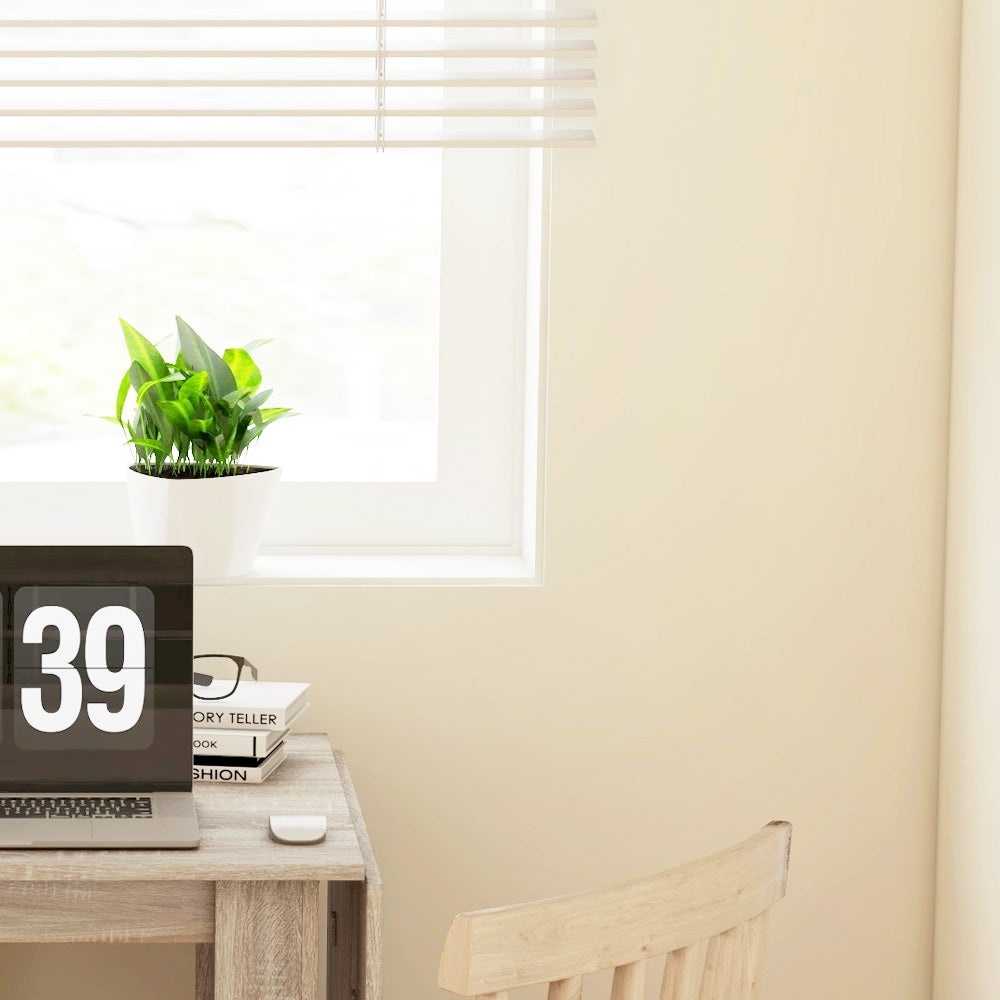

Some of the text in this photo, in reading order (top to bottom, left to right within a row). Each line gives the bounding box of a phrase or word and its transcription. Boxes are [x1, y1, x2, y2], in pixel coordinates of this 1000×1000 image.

[20, 605, 146, 733] 39
[193, 711, 277, 725] ORY TELLER
[193, 740, 218, 749] OOK
[193, 768, 247, 781] SHION
